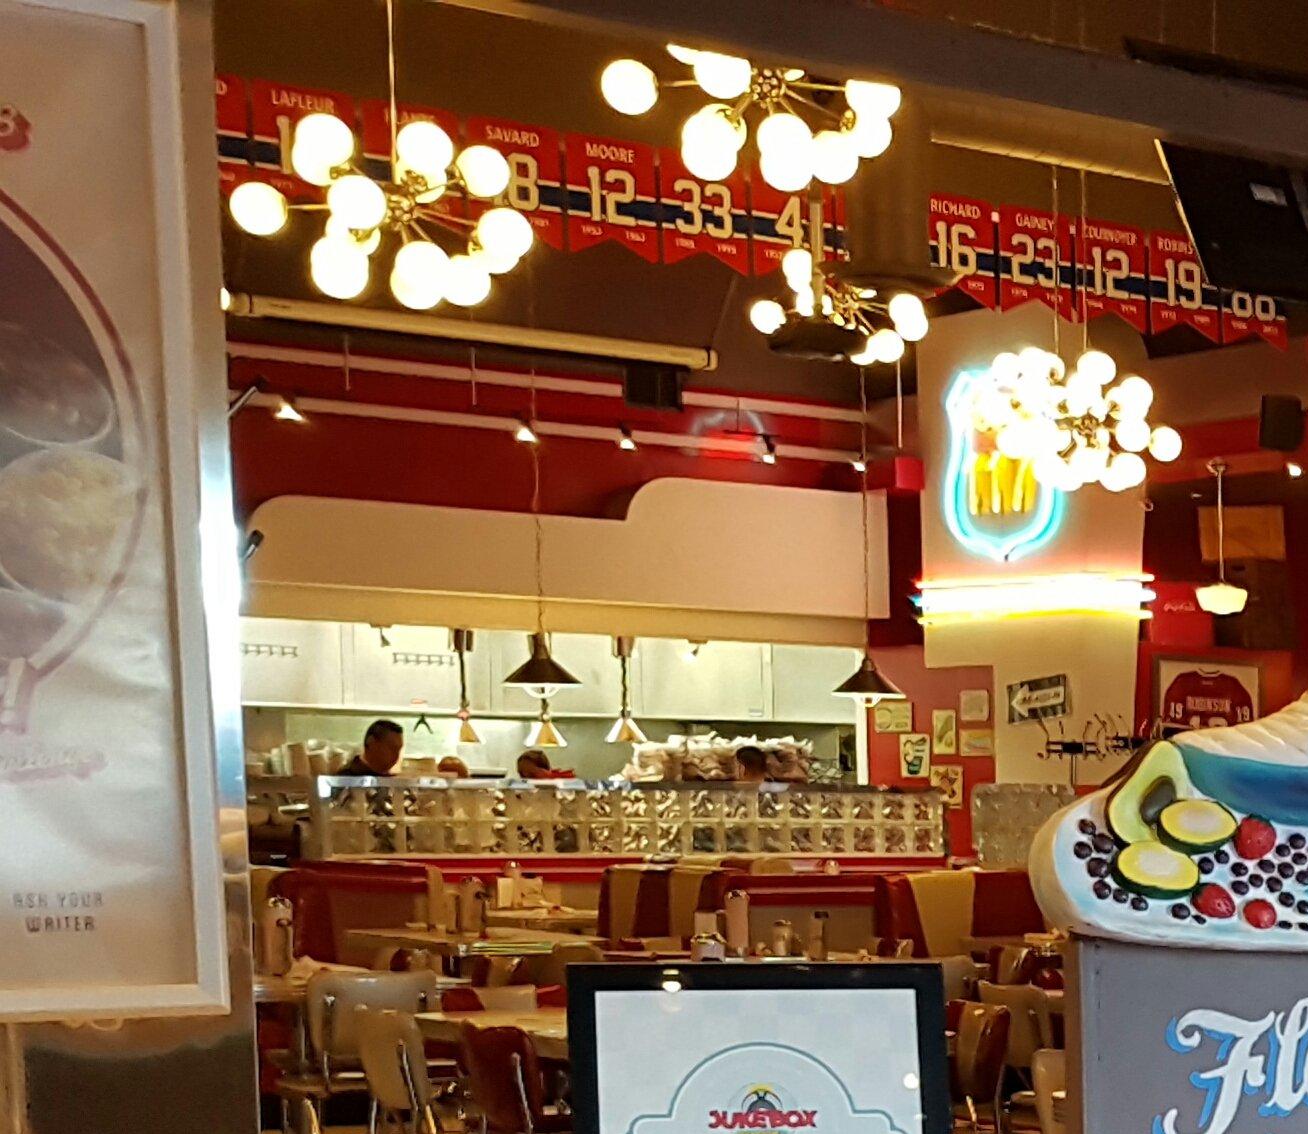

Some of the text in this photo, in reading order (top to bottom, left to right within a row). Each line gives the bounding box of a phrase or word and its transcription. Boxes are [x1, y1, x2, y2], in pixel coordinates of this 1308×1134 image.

[271, 89, 335, 113] LAFLEUR
[485, 124, 540, 148] SAVARD
[585, 142, 636, 164] MOORE
[505, 152, 541, 212] 8
[587, 165, 638, 228] 12
[930, 198, 982, 220] RICHARD
[674, 179, 734, 240] 33
[775, 195, 804, 249] 4
[1015, 212, 1055, 233] GAINEY
[936, 220, 978, 276] 16
[1011, 233, 1058, 289] 23
[1092, 246, 1131, 301] 12
[1164, 257, 1203, 310] 19
